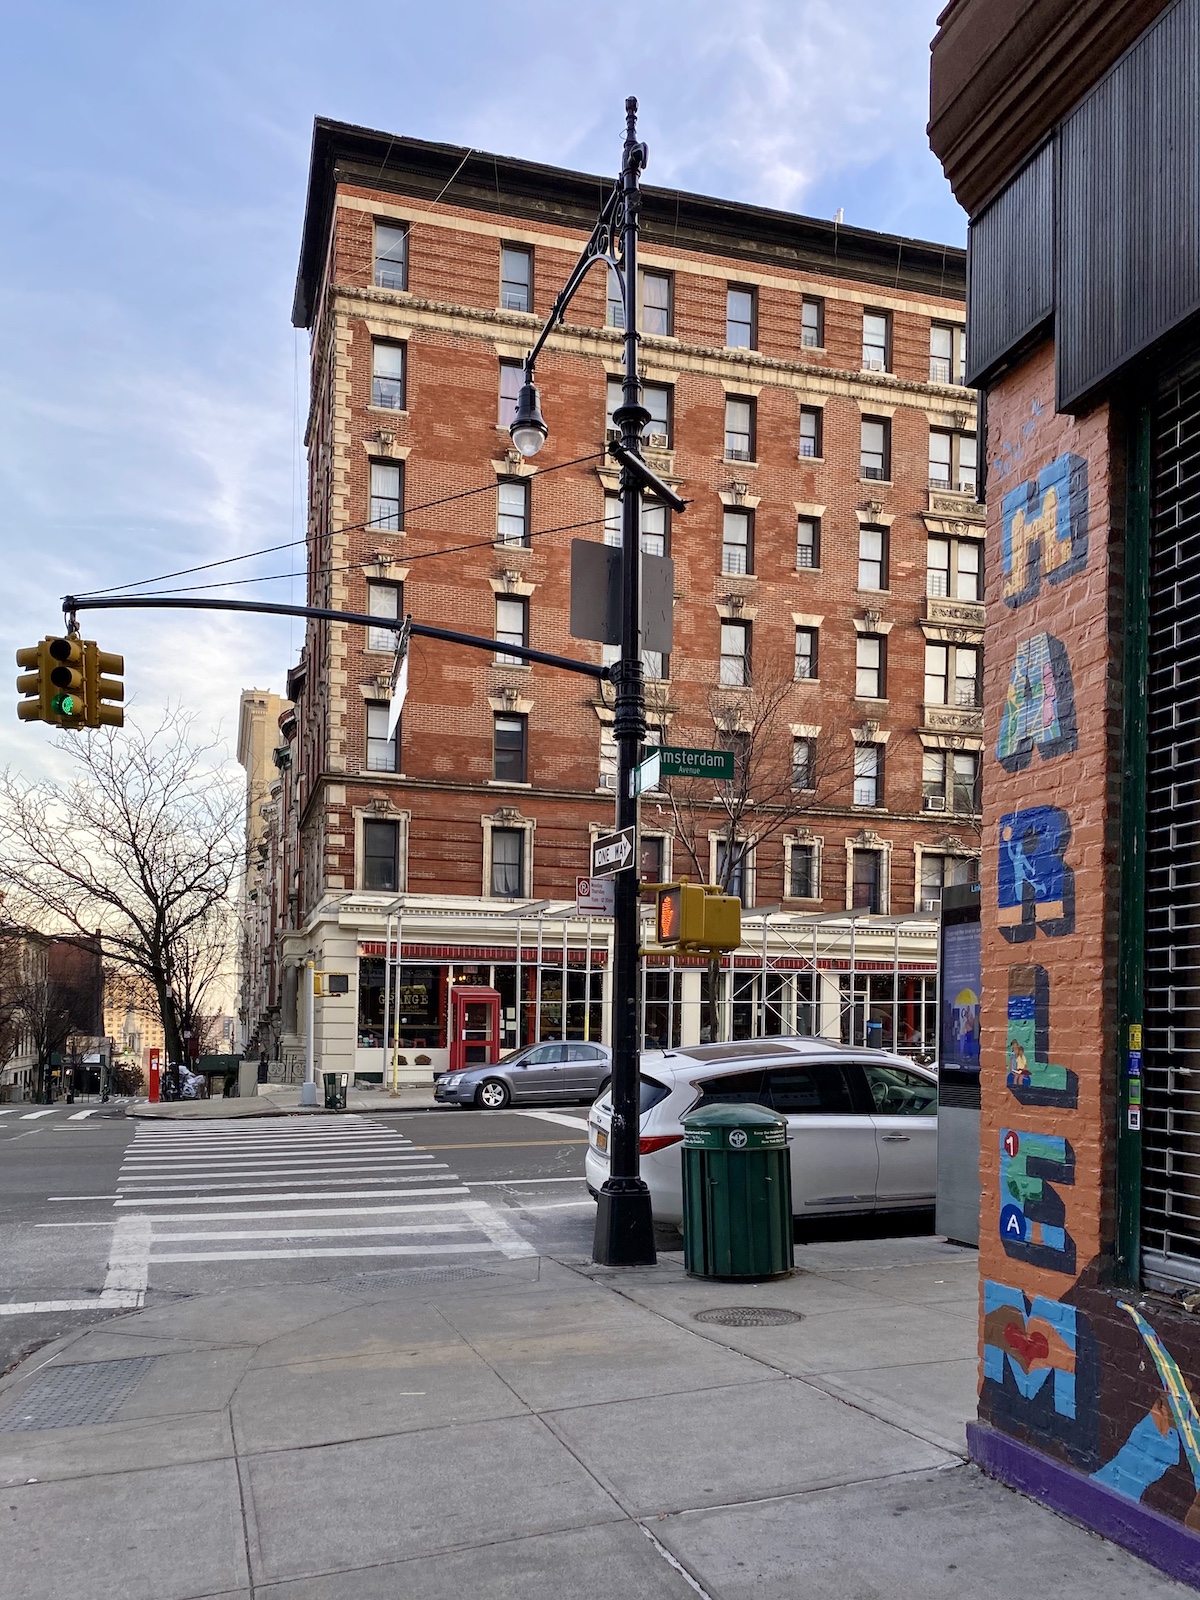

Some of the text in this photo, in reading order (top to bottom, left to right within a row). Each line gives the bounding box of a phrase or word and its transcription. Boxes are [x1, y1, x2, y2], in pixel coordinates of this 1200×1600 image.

[678, 766, 700, 775] Avenue
[597, 841, 628, 865] ONE WAY
[1006, 1136, 1014, 1156] 1
[1007, 1214, 1020, 1235] A
